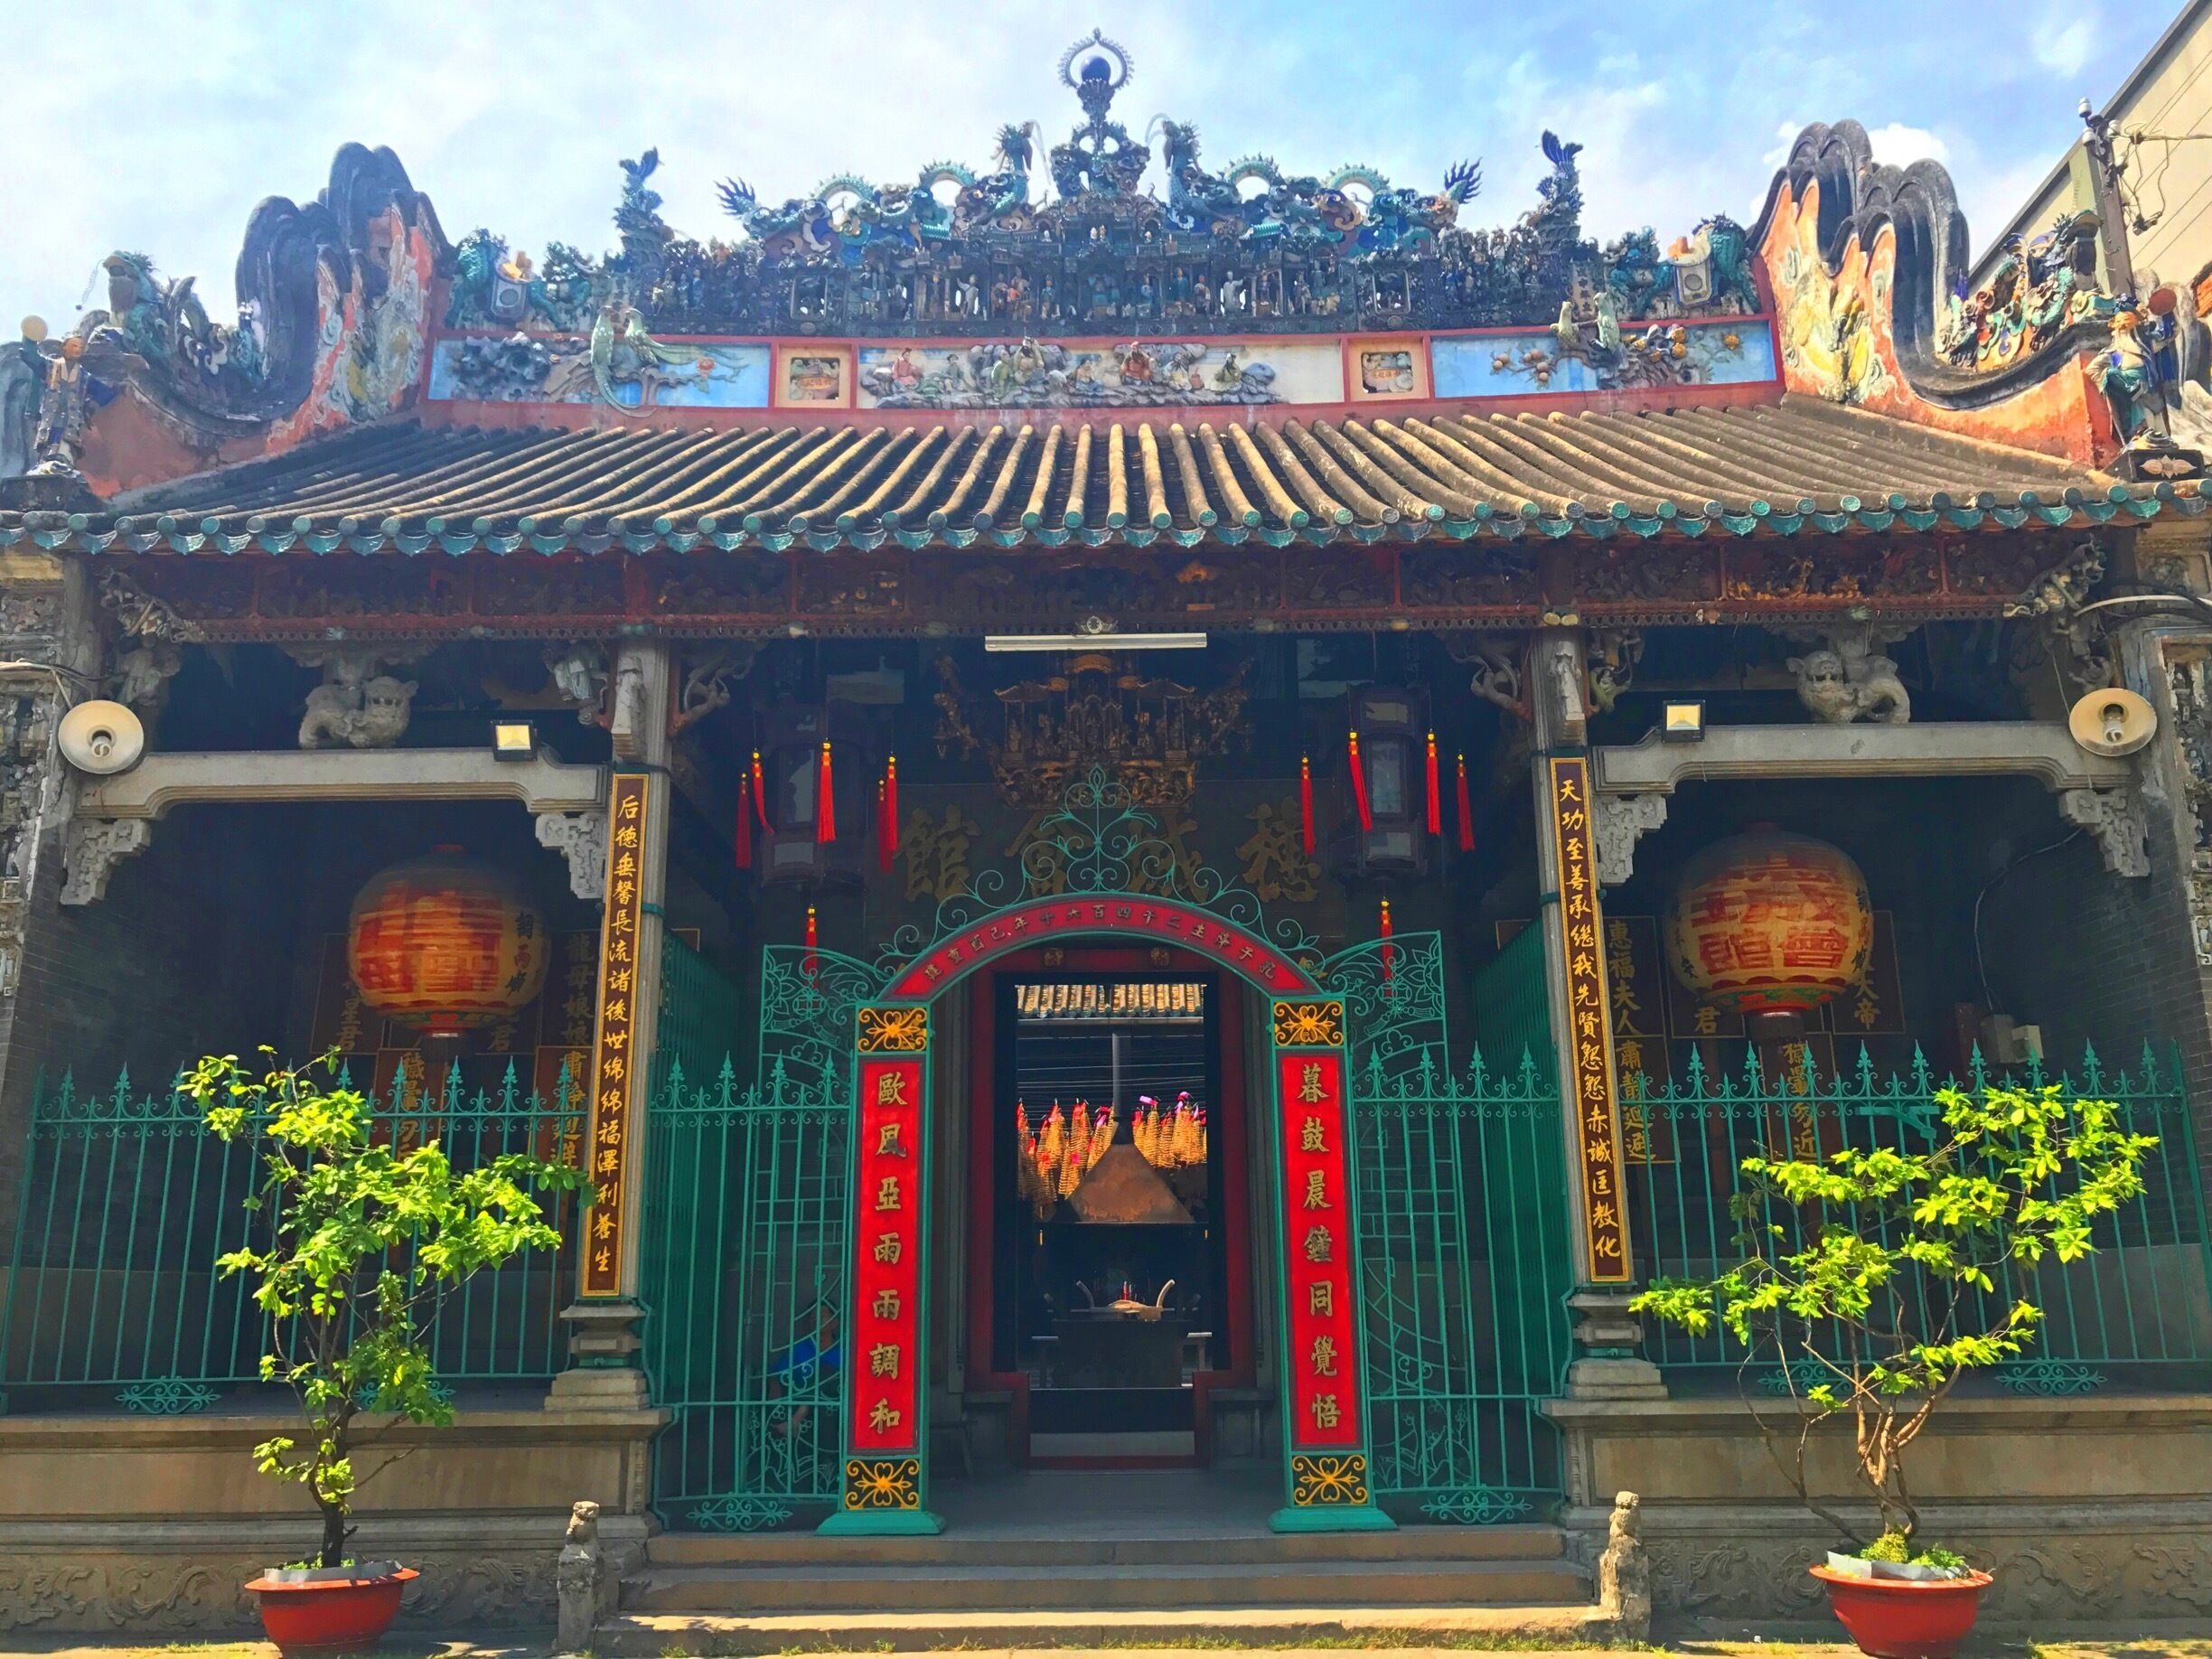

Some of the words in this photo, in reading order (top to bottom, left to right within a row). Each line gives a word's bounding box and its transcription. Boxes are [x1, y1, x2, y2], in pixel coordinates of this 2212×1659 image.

[1607, 920, 1643, 1036] 惠福夫人
[868, 1073, 908, 1435] 歐風亞雨雨調和
[1298, 1064, 1341, 1430] 暮鼓晨鐘同覺悟
